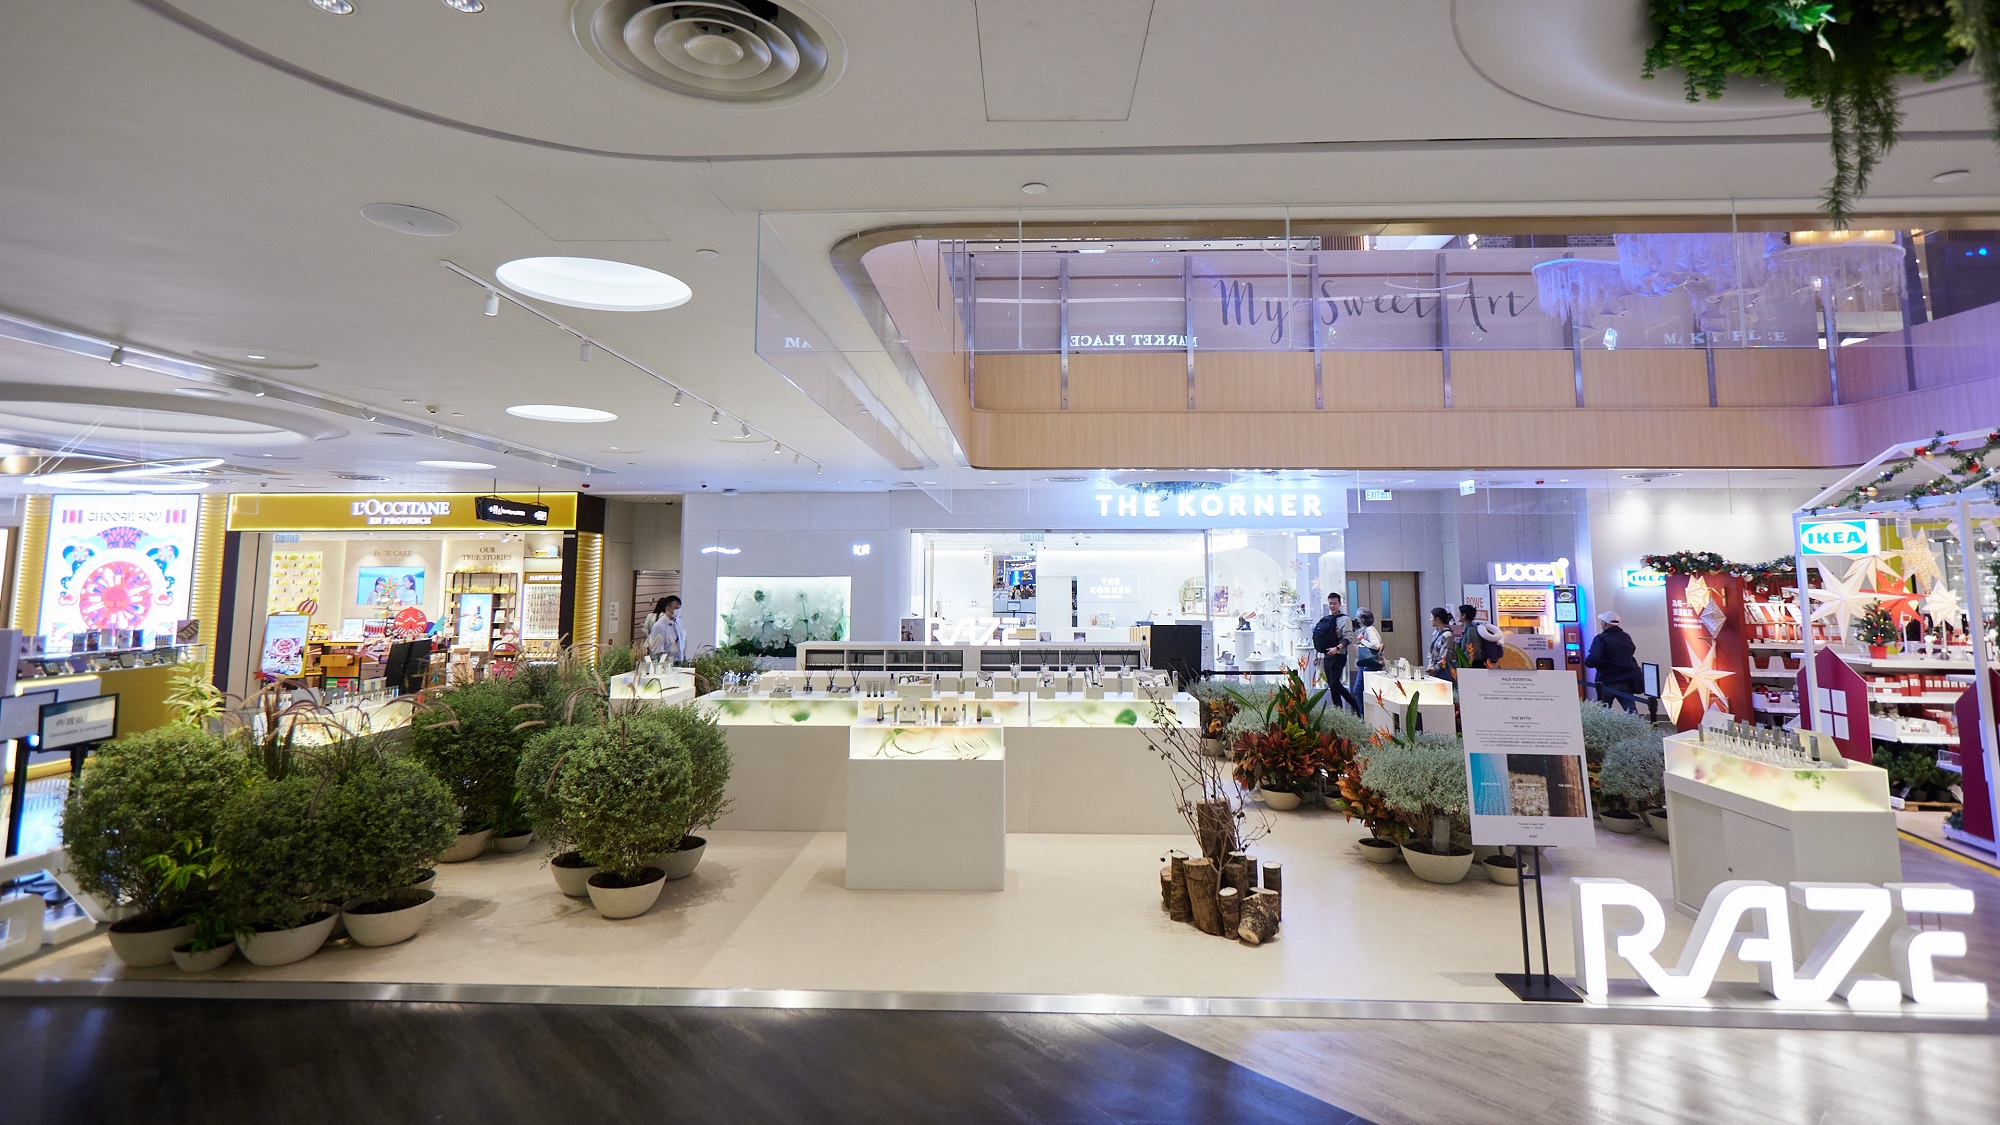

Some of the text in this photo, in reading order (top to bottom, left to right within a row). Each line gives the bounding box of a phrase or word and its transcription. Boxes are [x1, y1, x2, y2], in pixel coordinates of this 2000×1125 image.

[1214, 278, 1536, 344] My Sweet Art
[1367, 490, 1380, 499] EXIT
[352, 499, 451, 516] L'OCCITANE
[1095, 494, 1323, 517] THE KORNER
[368, 516, 432, 525] EN PROVENCE
[1808, 531, 1862, 544] IKEA
[1090, 586, 1132, 594] KORNER
[925, 617, 1021, 646] RAZE
[1572, 878, 1989, 1003] RAZE
